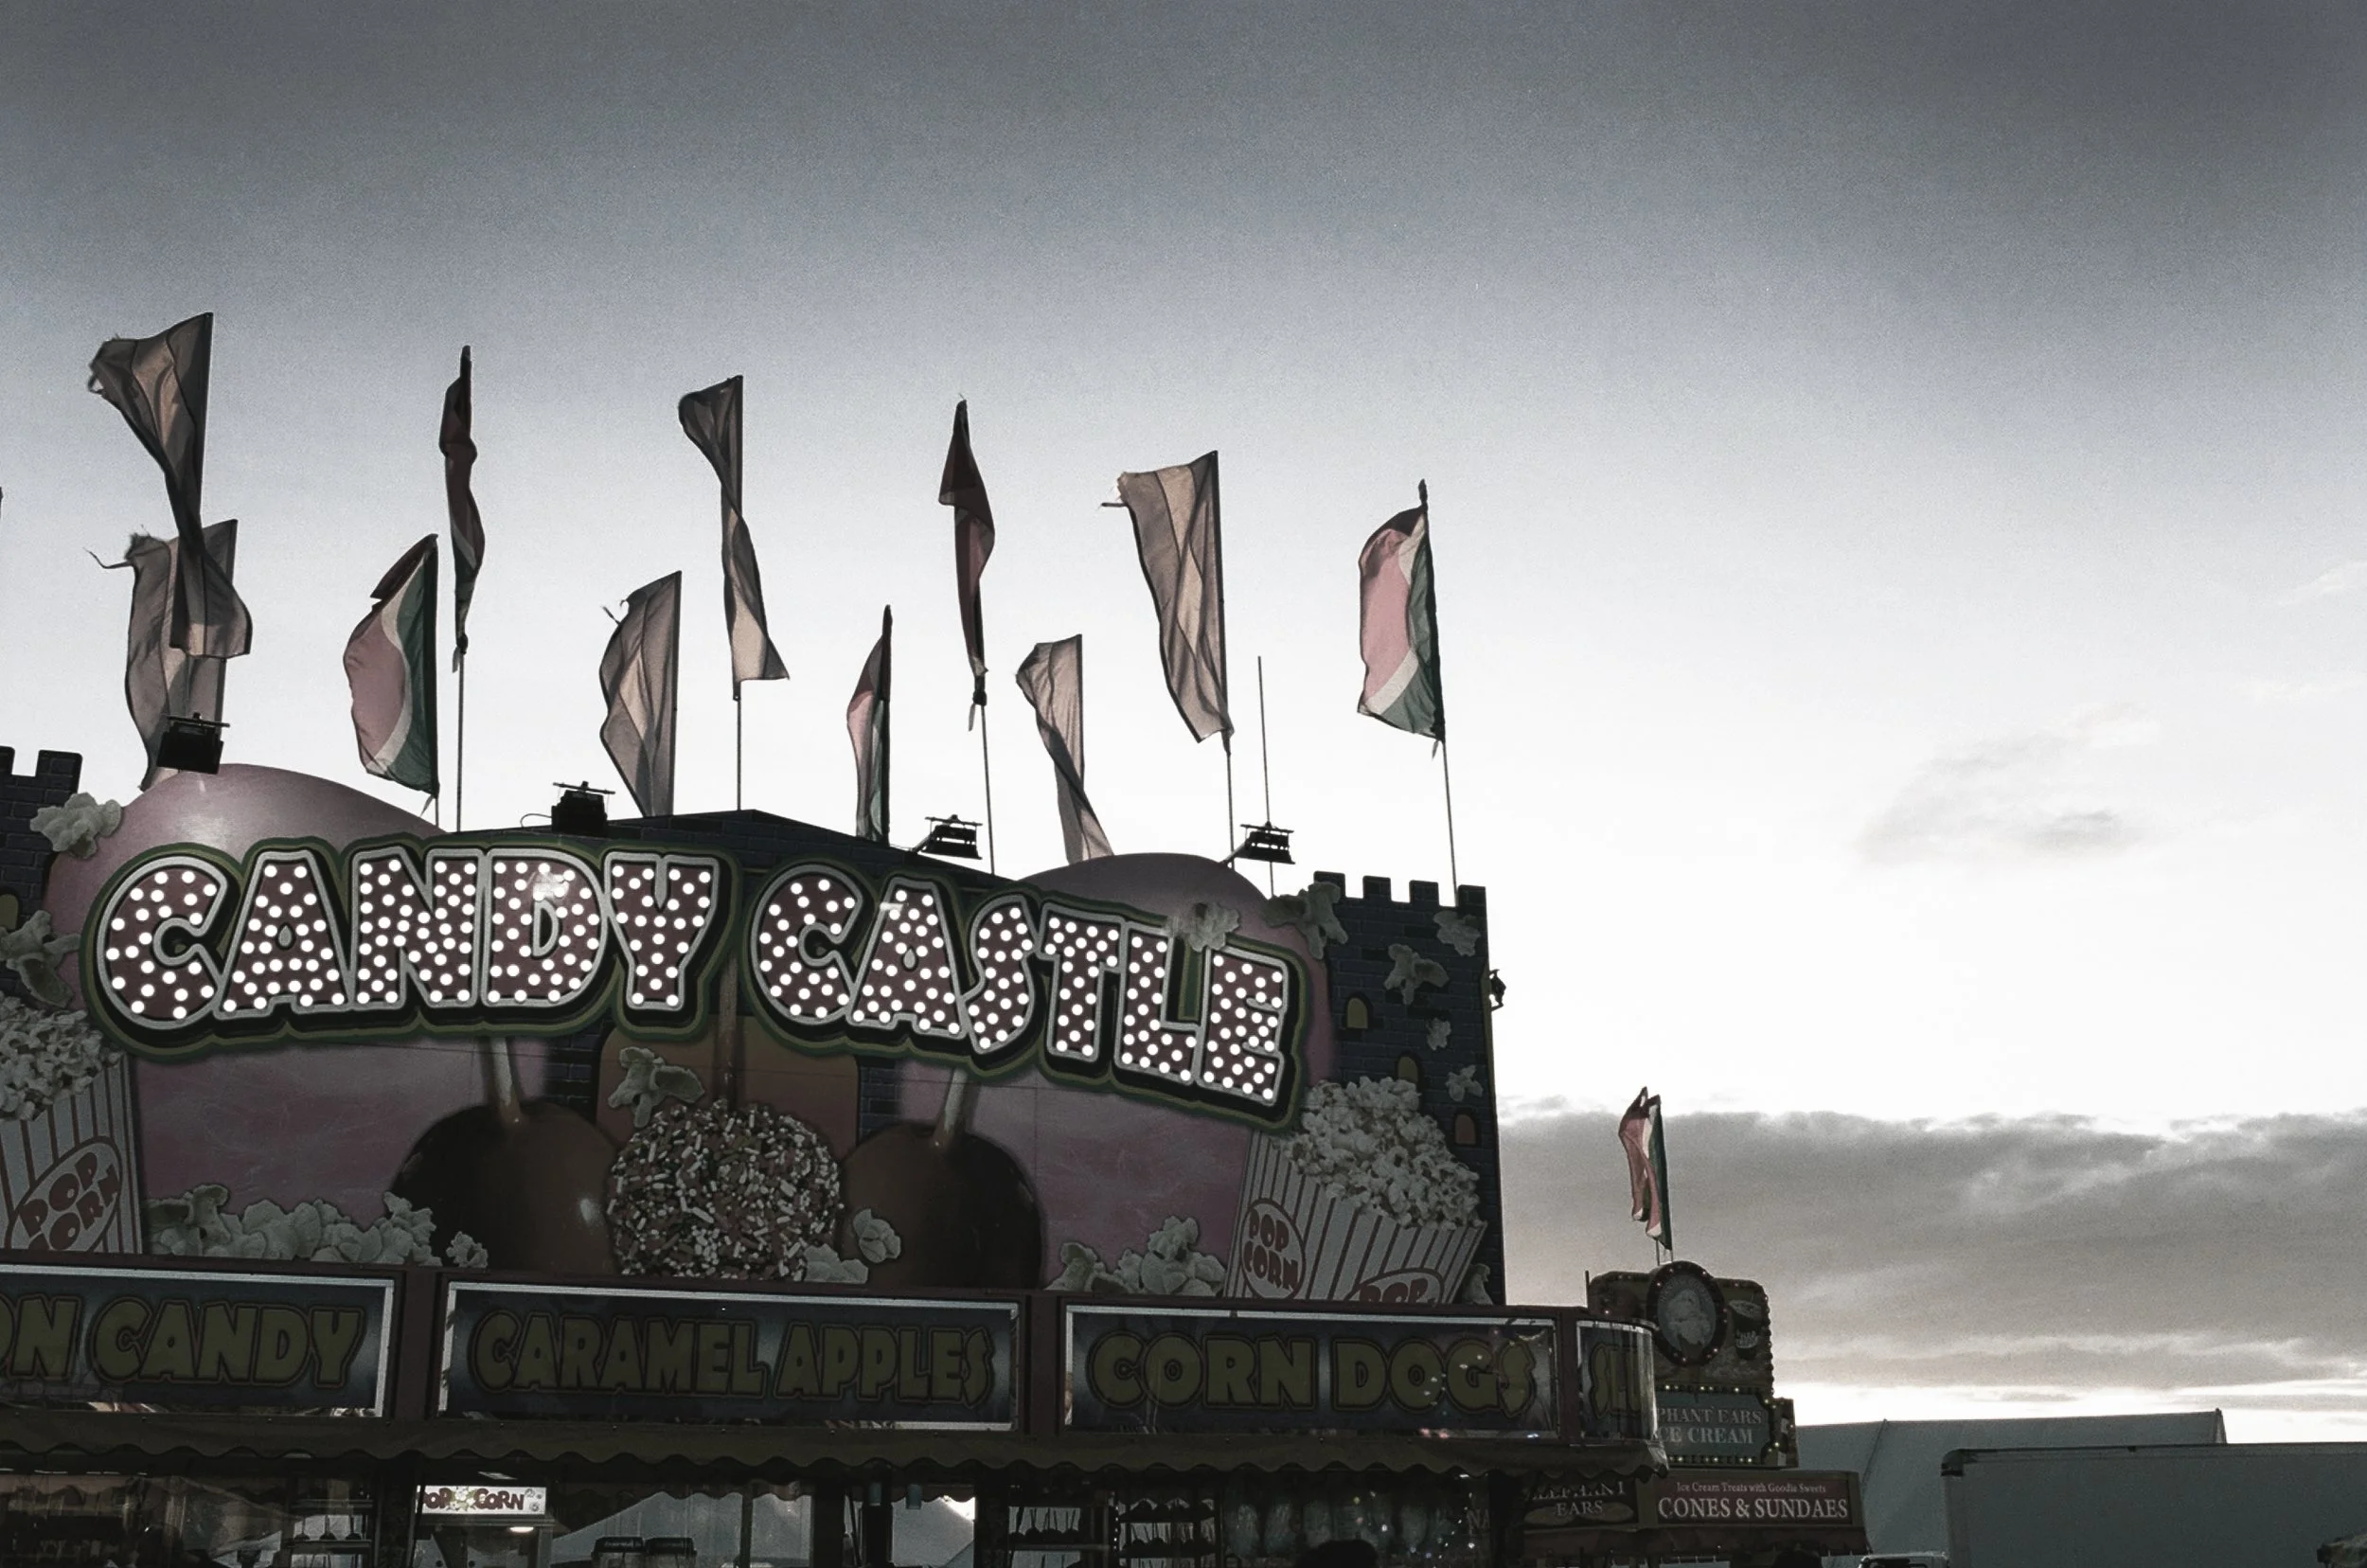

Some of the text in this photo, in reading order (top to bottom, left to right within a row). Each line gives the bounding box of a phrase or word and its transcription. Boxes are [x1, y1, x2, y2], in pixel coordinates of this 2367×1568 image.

[96, 846, 1290, 1107] CANDY CASTLE
[19, 1152, 98, 1238] POP
[1249, 1207, 1290, 1253] POP
[1243, 1240, 1299, 1292] CORN
[93, 1295, 366, 1389] CANDY
[473, 1310, 996, 1407] CARAMEL APPLES
[1088, 1329, 1317, 1411] CORN
[1329, 1335, 1536, 1419] DOGS
[1687, 1427, 1753, 1444] CREAM
[422, 1488, 525, 1510] OP CORN
[1555, 1499, 1604, 1517] EARS
[1658, 1497, 1848, 1520] CONES & SUNDAES
[1676, 1481, 1690, 1492] Ice
[1692, 1481, 1719, 1493] Cream
[1721, 1481, 1748, 1493] Treats
